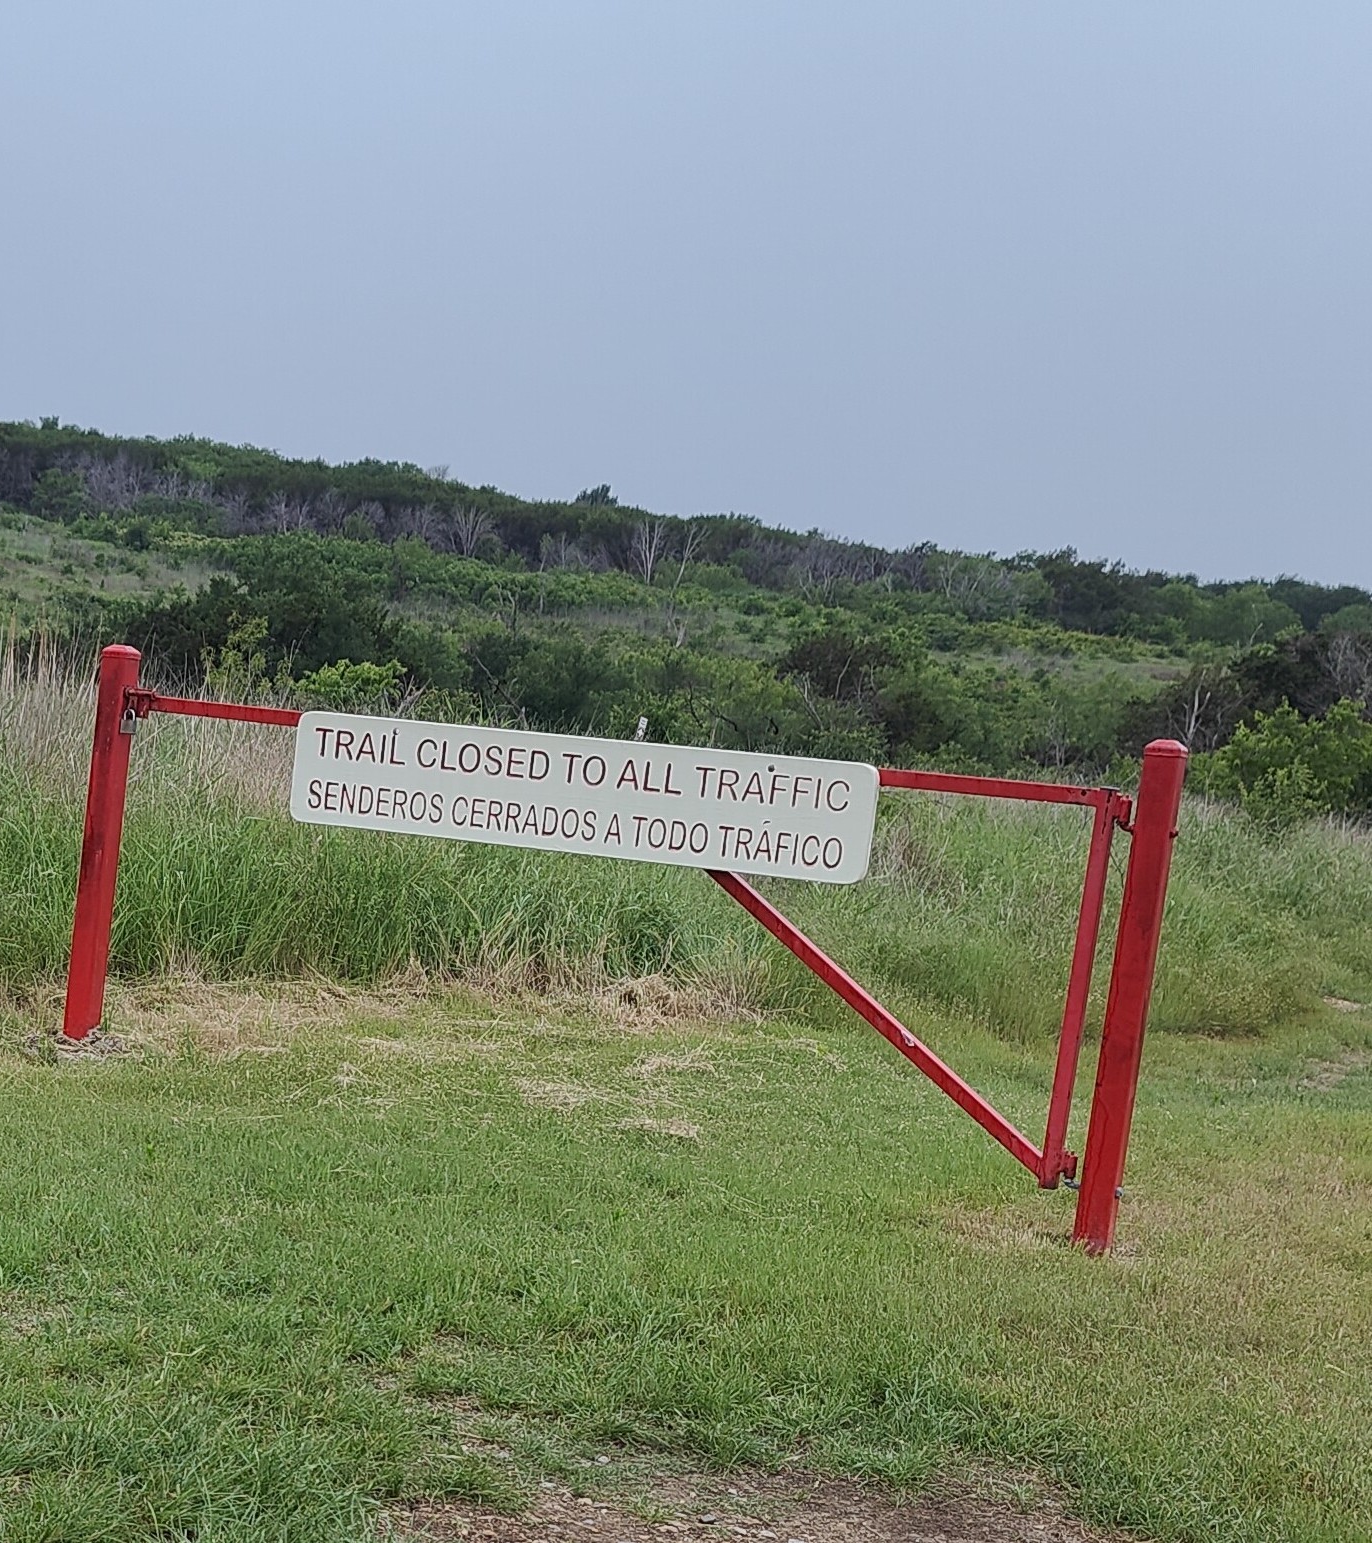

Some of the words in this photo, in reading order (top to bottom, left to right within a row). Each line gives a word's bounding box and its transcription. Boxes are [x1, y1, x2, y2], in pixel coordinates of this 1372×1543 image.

[315, 727, 406, 766] TRAIL
[416, 738, 550, 781] CLOSED
[562, 753, 607, 786] TO
[616, 759, 682, 796] ALL
[695, 766, 850, 812] TRAFFIC
[307, 779, 444, 824] SENDEROS
[451, 796, 597, 842] CERRADOS
[603, 813, 621, 845] A
[632, 815, 709, 854] TODO
[718, 820, 843, 870] TRÁFICO
